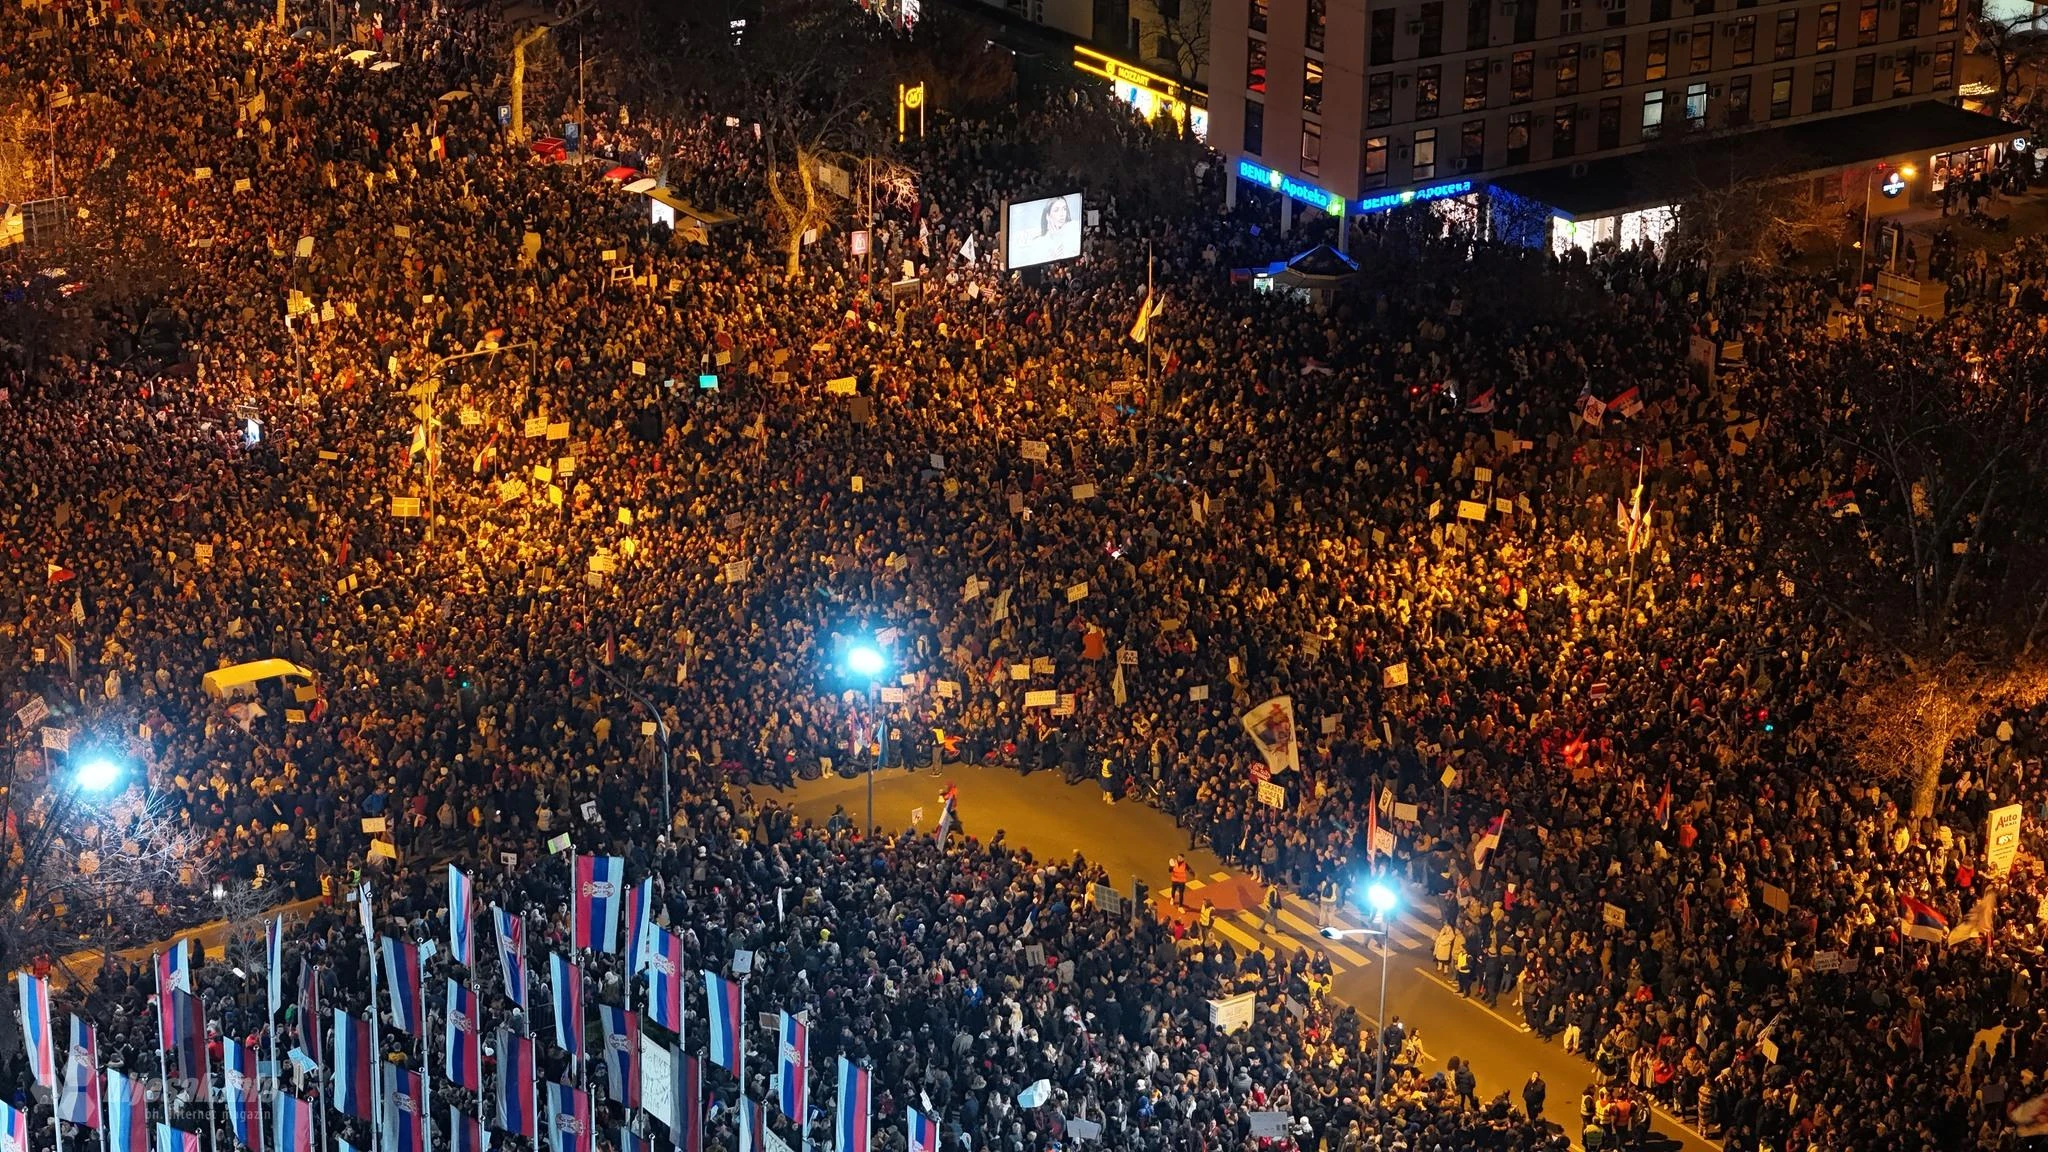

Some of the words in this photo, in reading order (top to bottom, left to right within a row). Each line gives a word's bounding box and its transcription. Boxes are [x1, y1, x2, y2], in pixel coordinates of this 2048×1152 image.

[1118, 66, 1150, 87] MOZZART
[501, 107, 508, 118] P
[1240, 162, 1270, 185] BENU
[1282, 178, 1327, 207] Apoteka
[1362, 194, 1399, 210] BENU
[1995, 813, 2018, 832] Auto
